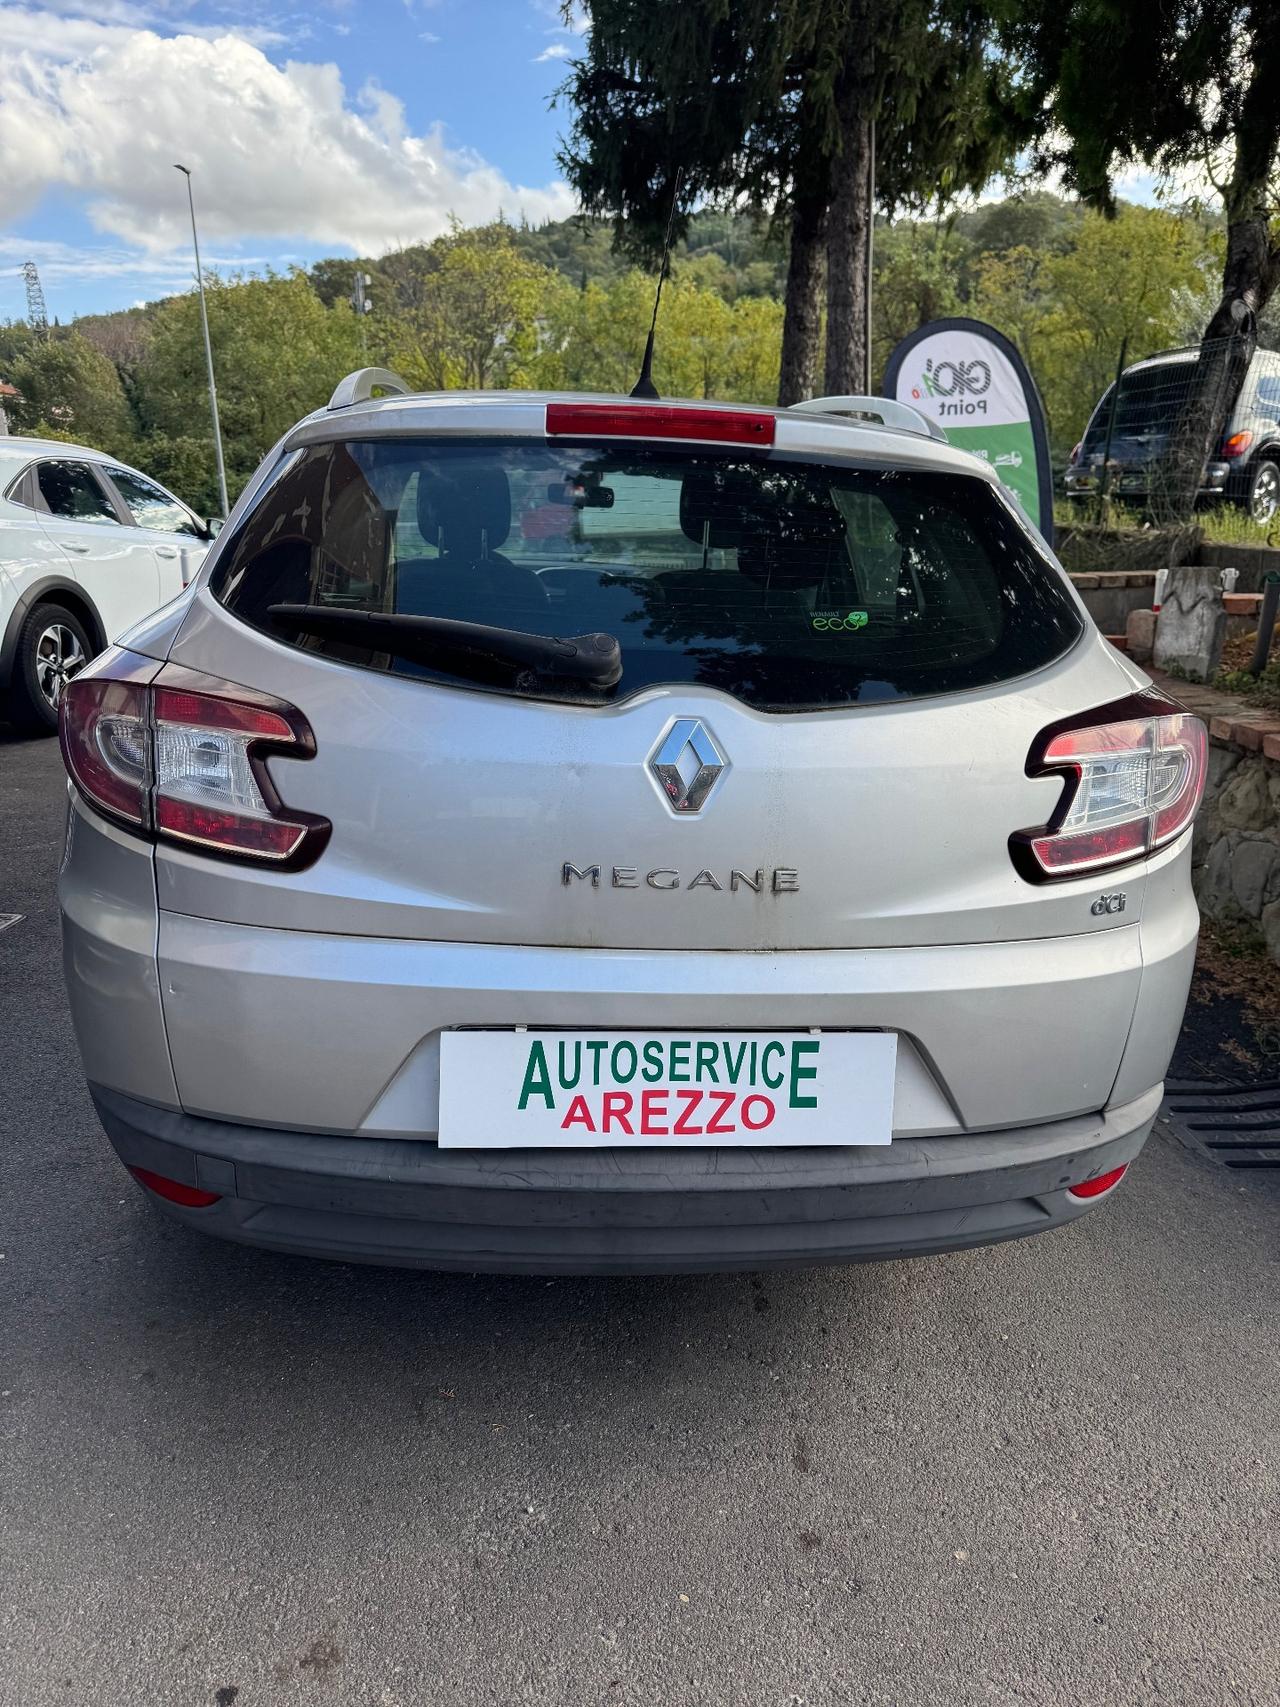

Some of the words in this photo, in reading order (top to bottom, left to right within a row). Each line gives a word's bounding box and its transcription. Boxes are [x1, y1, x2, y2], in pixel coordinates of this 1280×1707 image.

[561, 862, 800, 892] MEGANE
[1090, 892, 1126, 916] dCi
[517, 1040, 820, 1109] AUTOSERVICE
[560, 1089, 776, 1135] AREZZO
